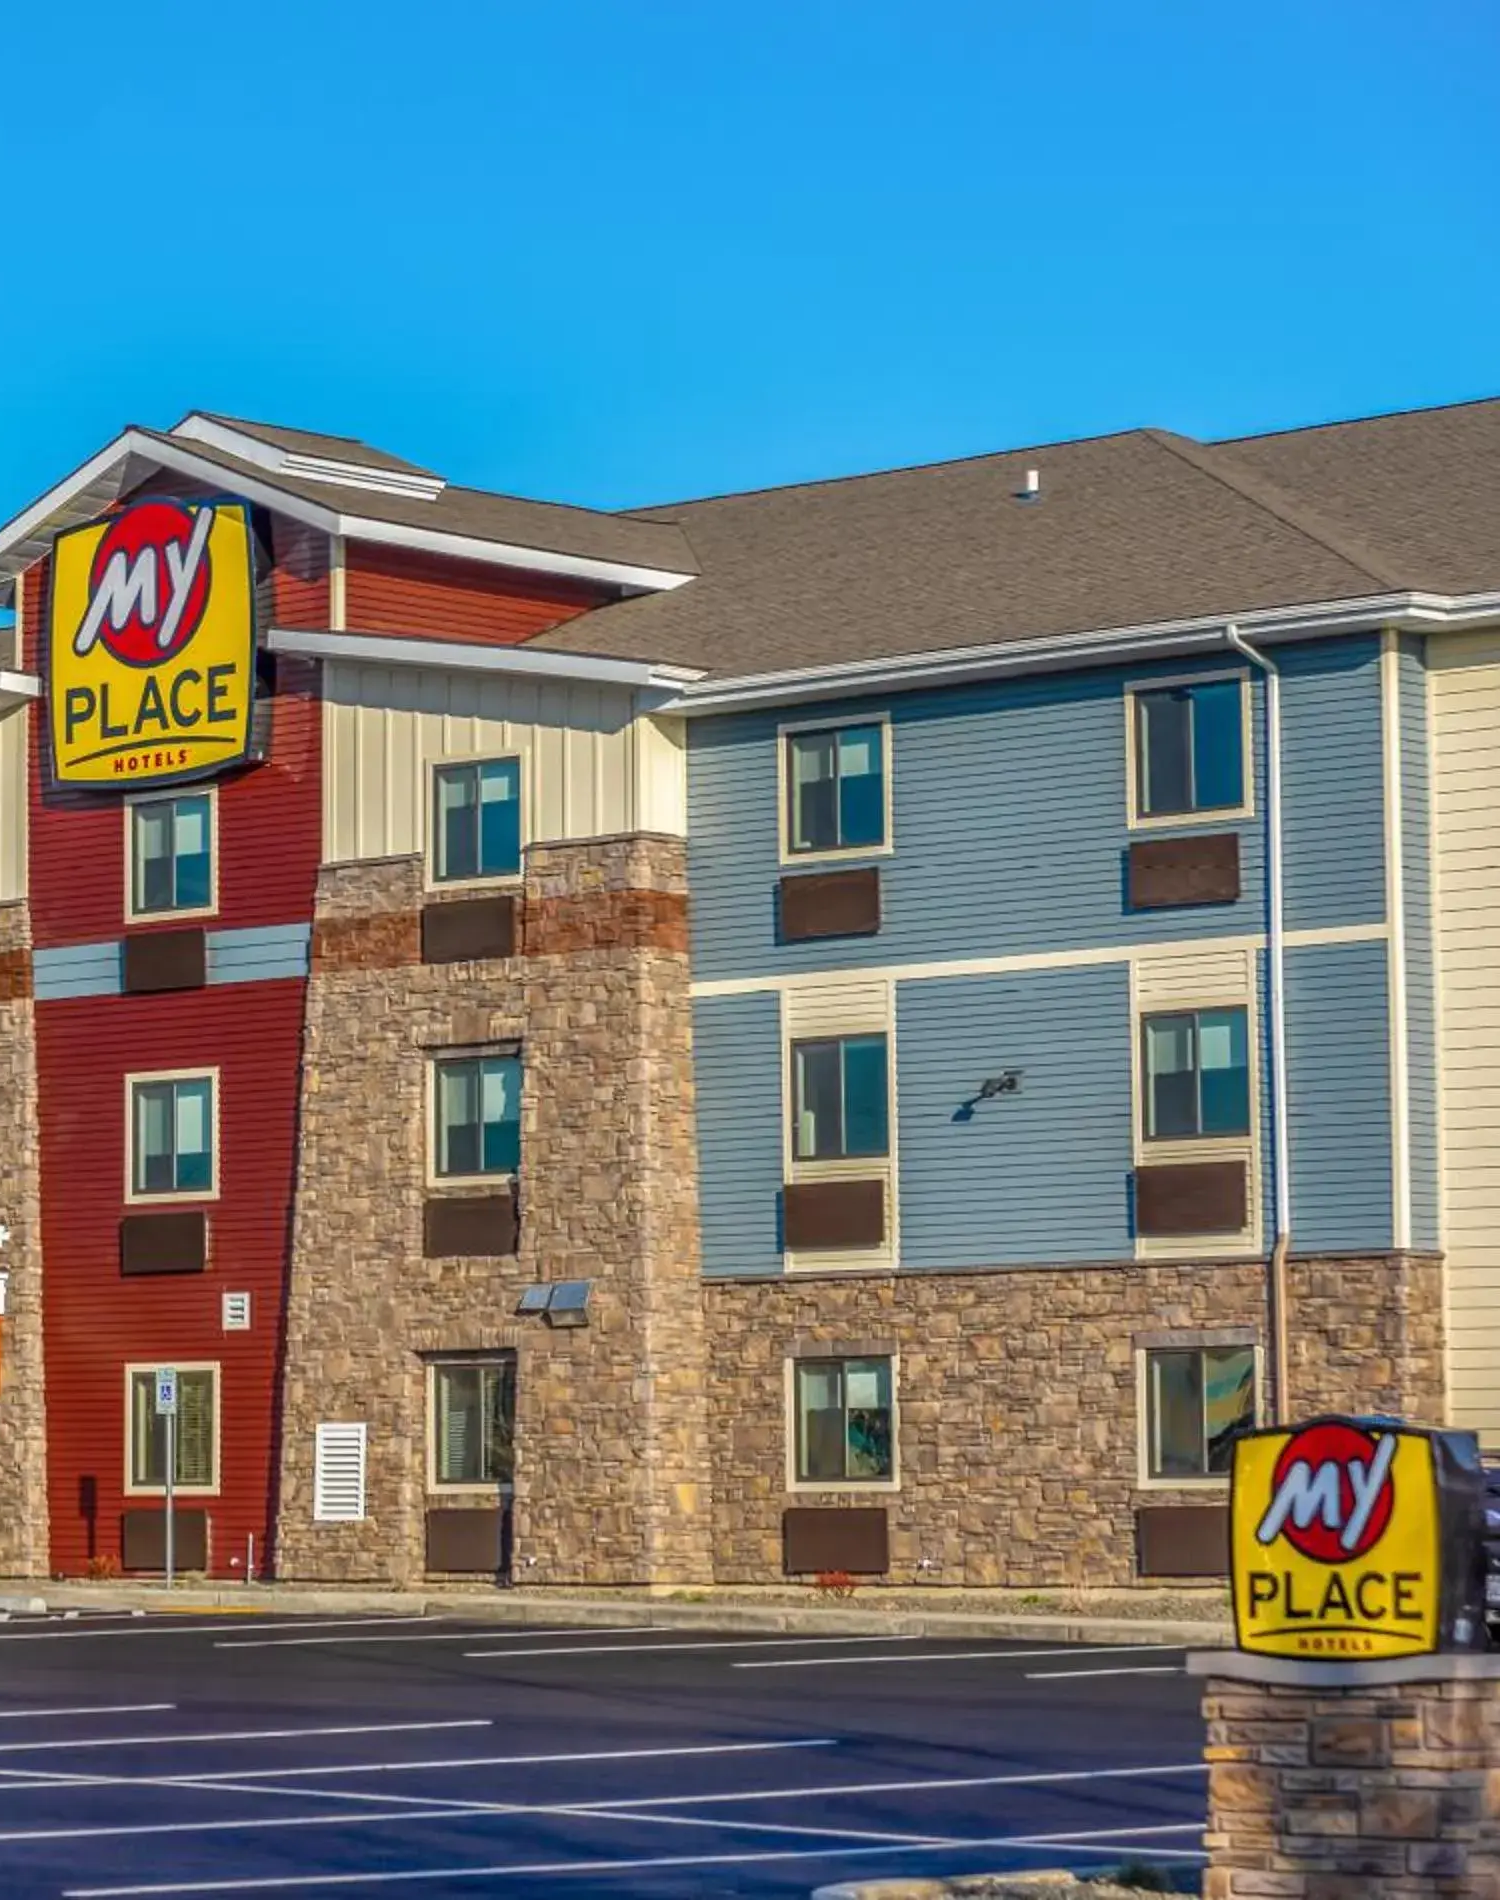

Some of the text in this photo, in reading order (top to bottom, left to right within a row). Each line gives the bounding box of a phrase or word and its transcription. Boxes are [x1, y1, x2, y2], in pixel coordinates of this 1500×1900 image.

[65, 663, 237, 744] PLACE
[113, 749, 189, 773] HOTELS
[1248, 1571, 1423, 1620] PLACE
